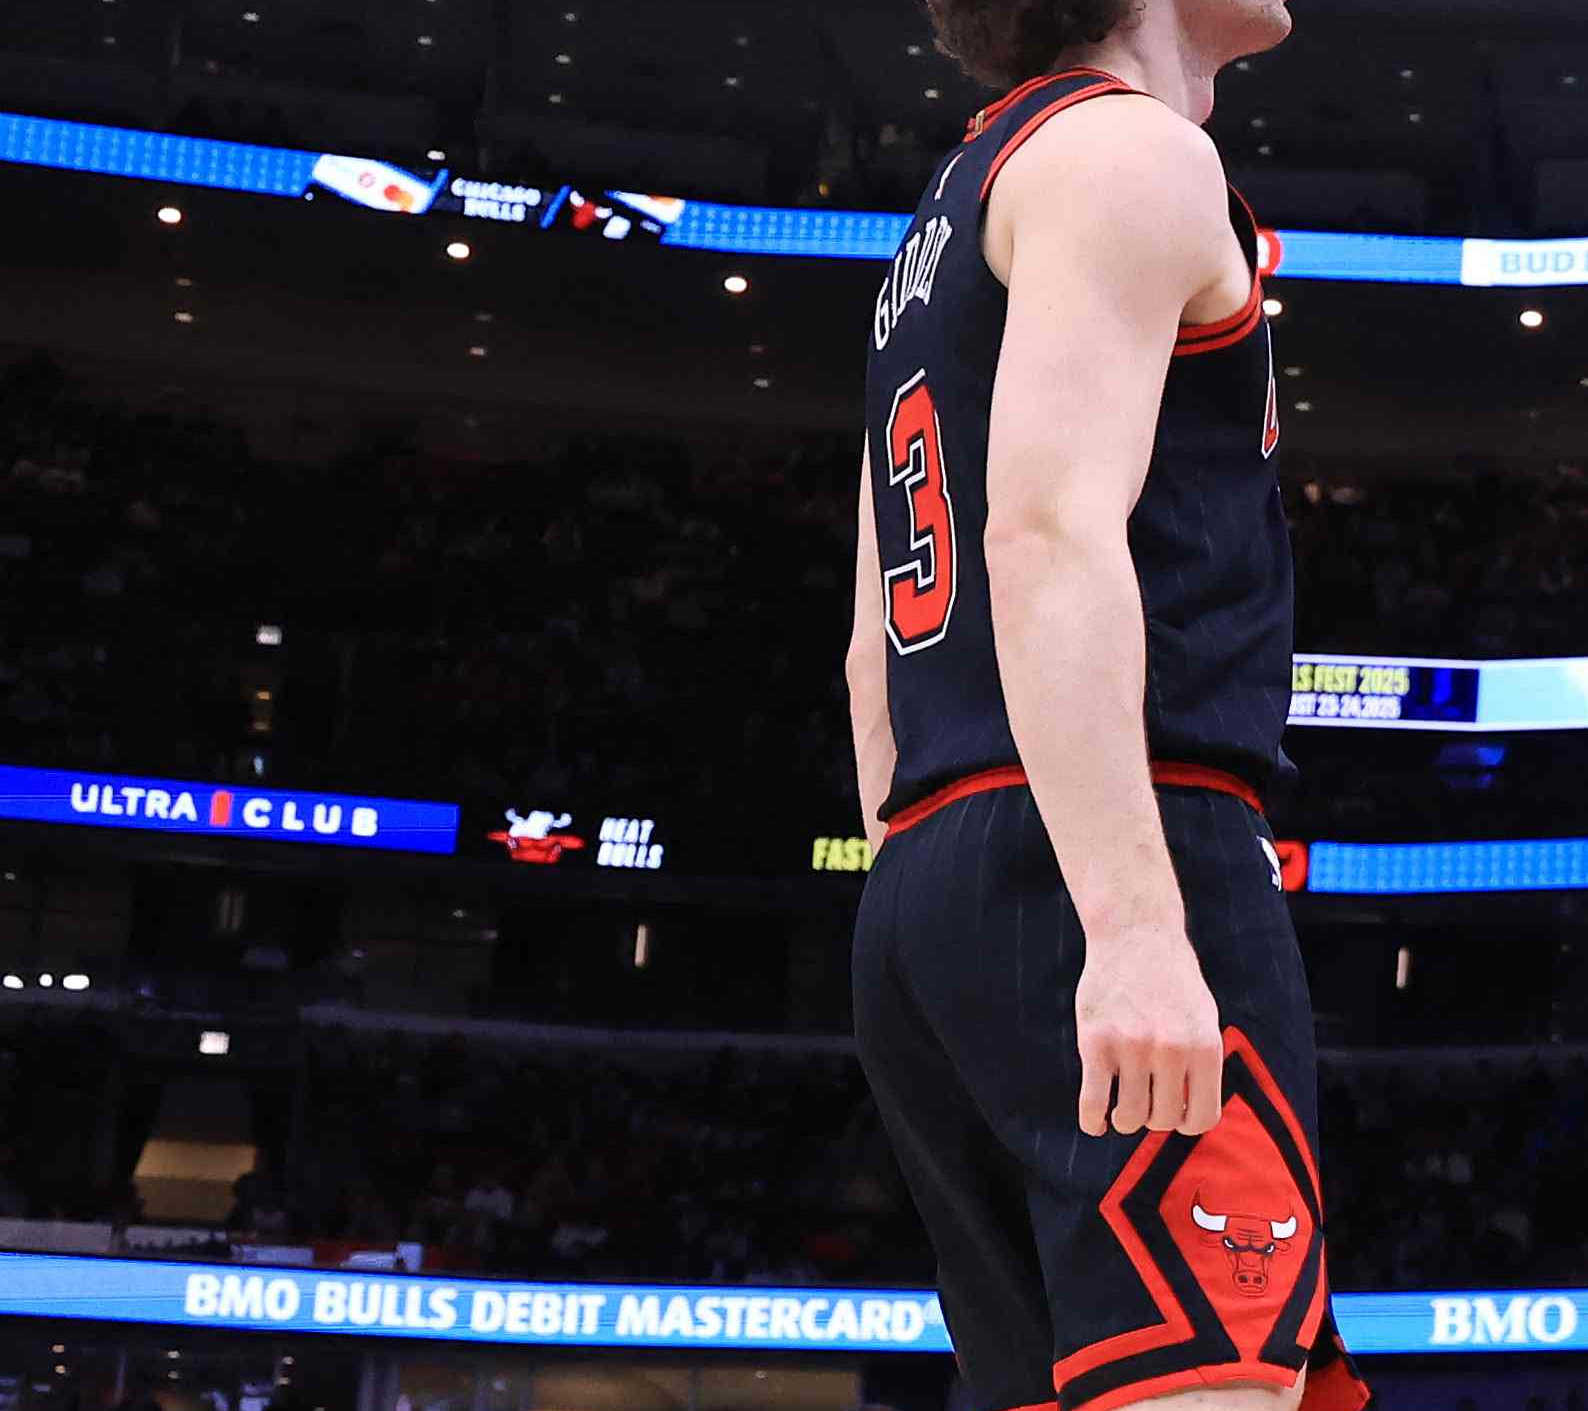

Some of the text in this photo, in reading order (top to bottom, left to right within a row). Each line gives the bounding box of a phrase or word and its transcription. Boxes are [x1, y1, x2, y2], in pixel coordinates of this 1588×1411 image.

[1499, 248, 1578, 277] BUD
[884, 368, 958, 657] 3
[71, 783, 380, 838] ULTRA CLUB
[186, 1273, 301, 1322] BMO
[314, 1281, 459, 1331] BULLS
[471, 1290, 607, 1336] DEBIT
[1431, 1296, 1579, 1346] BMO
